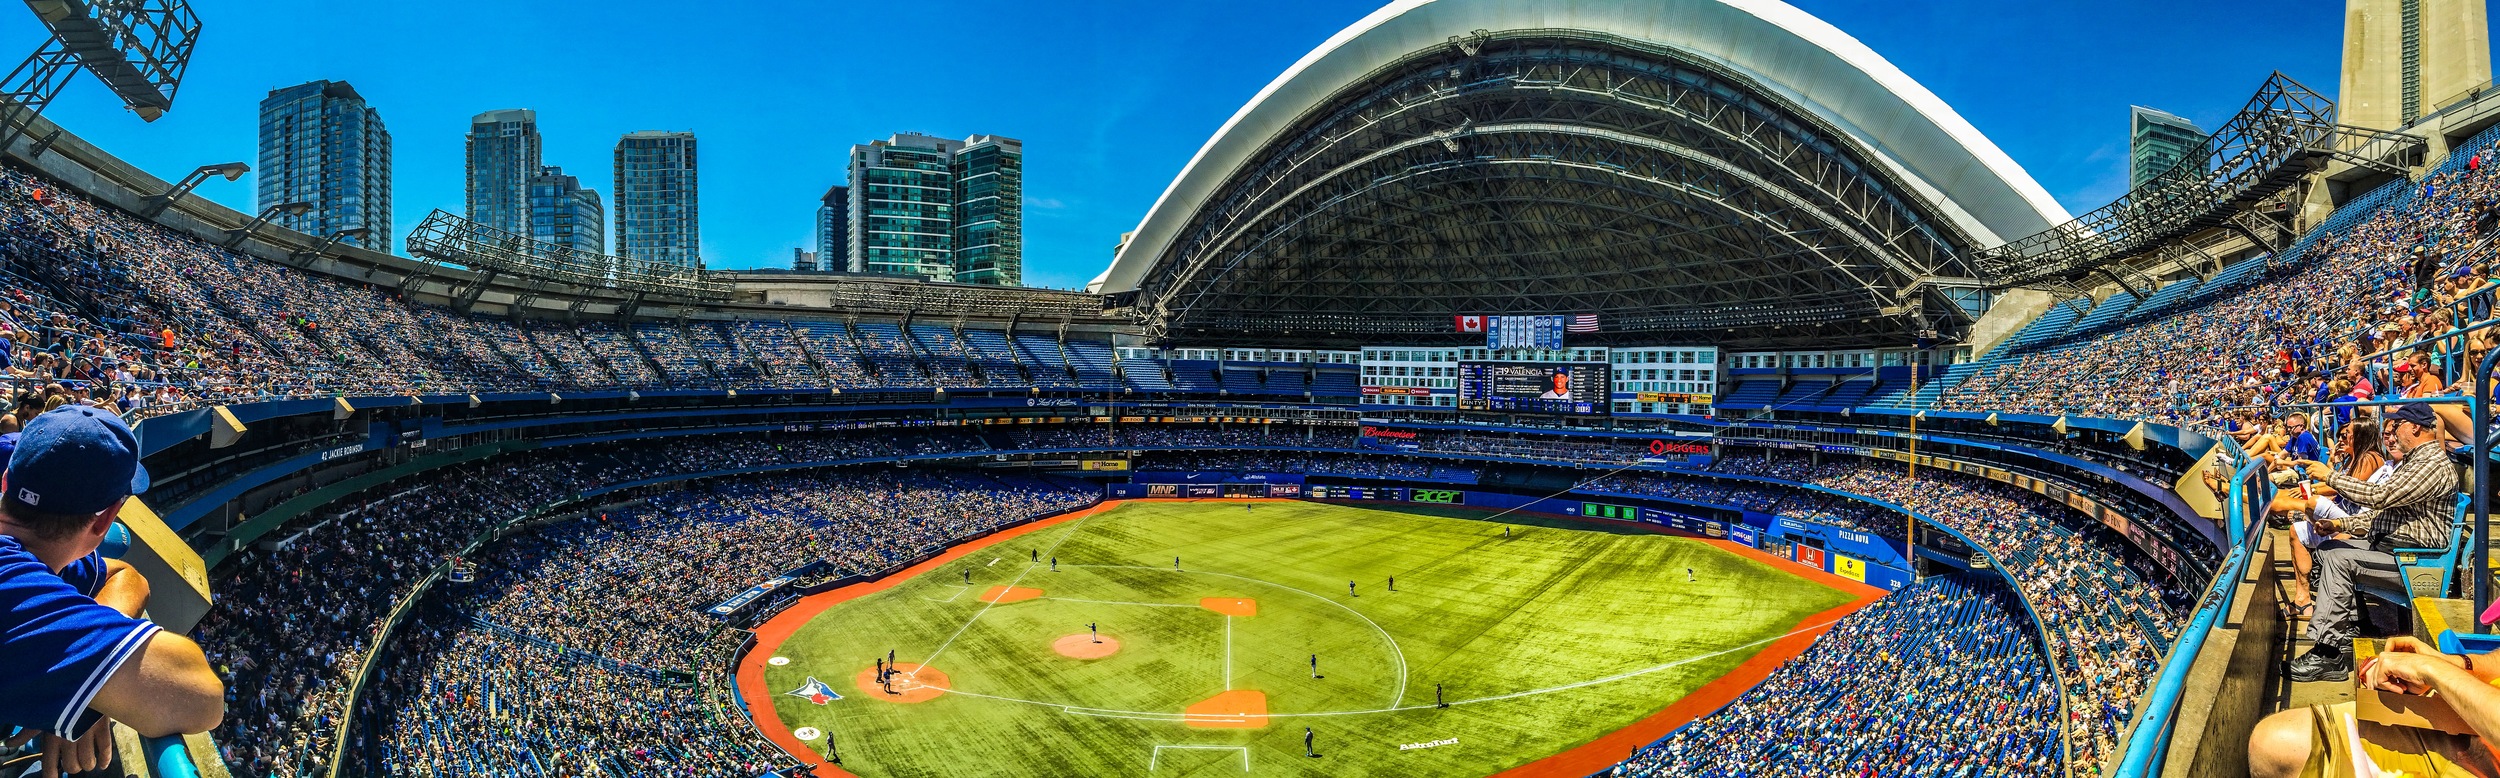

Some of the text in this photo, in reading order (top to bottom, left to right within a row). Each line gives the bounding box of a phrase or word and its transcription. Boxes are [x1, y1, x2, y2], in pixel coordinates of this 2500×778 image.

[1553, 330, 1562, 339] 12
[1501, 367, 1510, 375] 19
[1510, 368, 1543, 376] VALENCIA
[1362, 426, 1416, 439] Budweiser
[321, 443, 364, 460] 42 JACKIE ROBINSON
[1666, 443, 1709, 454] ROGERS
[1150, 485, 1175, 494] MNP
[1414, 489, 1460, 503] acer
[1838, 529, 1869, 544] PIZZA NOVA
[1802, 559, 1818, 568] HONDA
[1890, 579, 1901, 588] 328
[1399, 737, 1459, 751] AstroTurf
